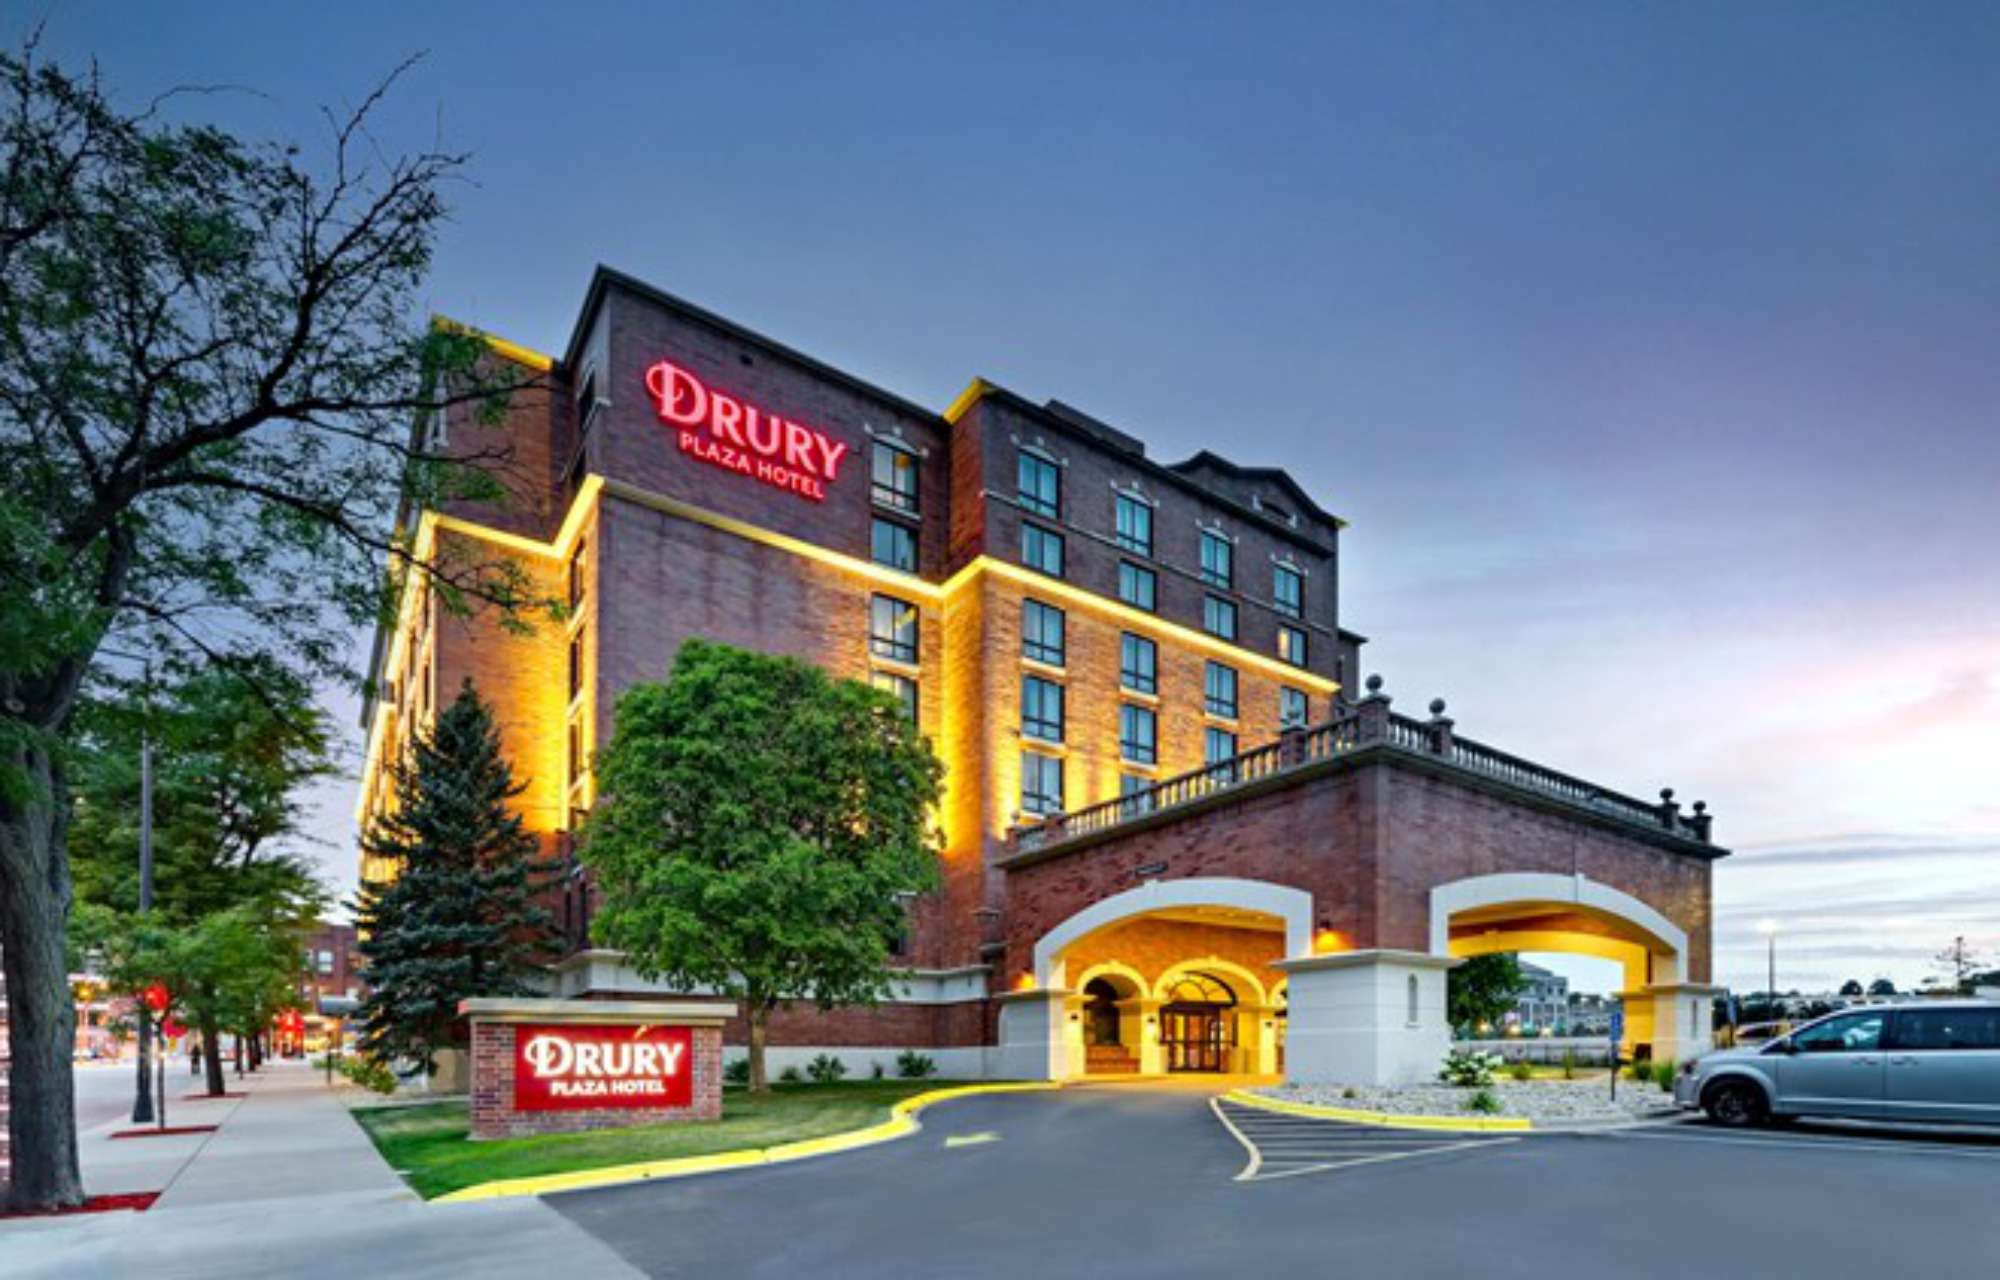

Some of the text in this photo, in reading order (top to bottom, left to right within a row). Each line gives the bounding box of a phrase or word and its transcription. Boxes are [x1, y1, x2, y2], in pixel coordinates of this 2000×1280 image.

[645, 360, 845, 480] DRURY
[679, 432, 824, 499] PLAZA HOTEL
[524, 1035, 684, 1078] DRURY
[551, 1079, 666, 1096] PLAZA HOTEL
